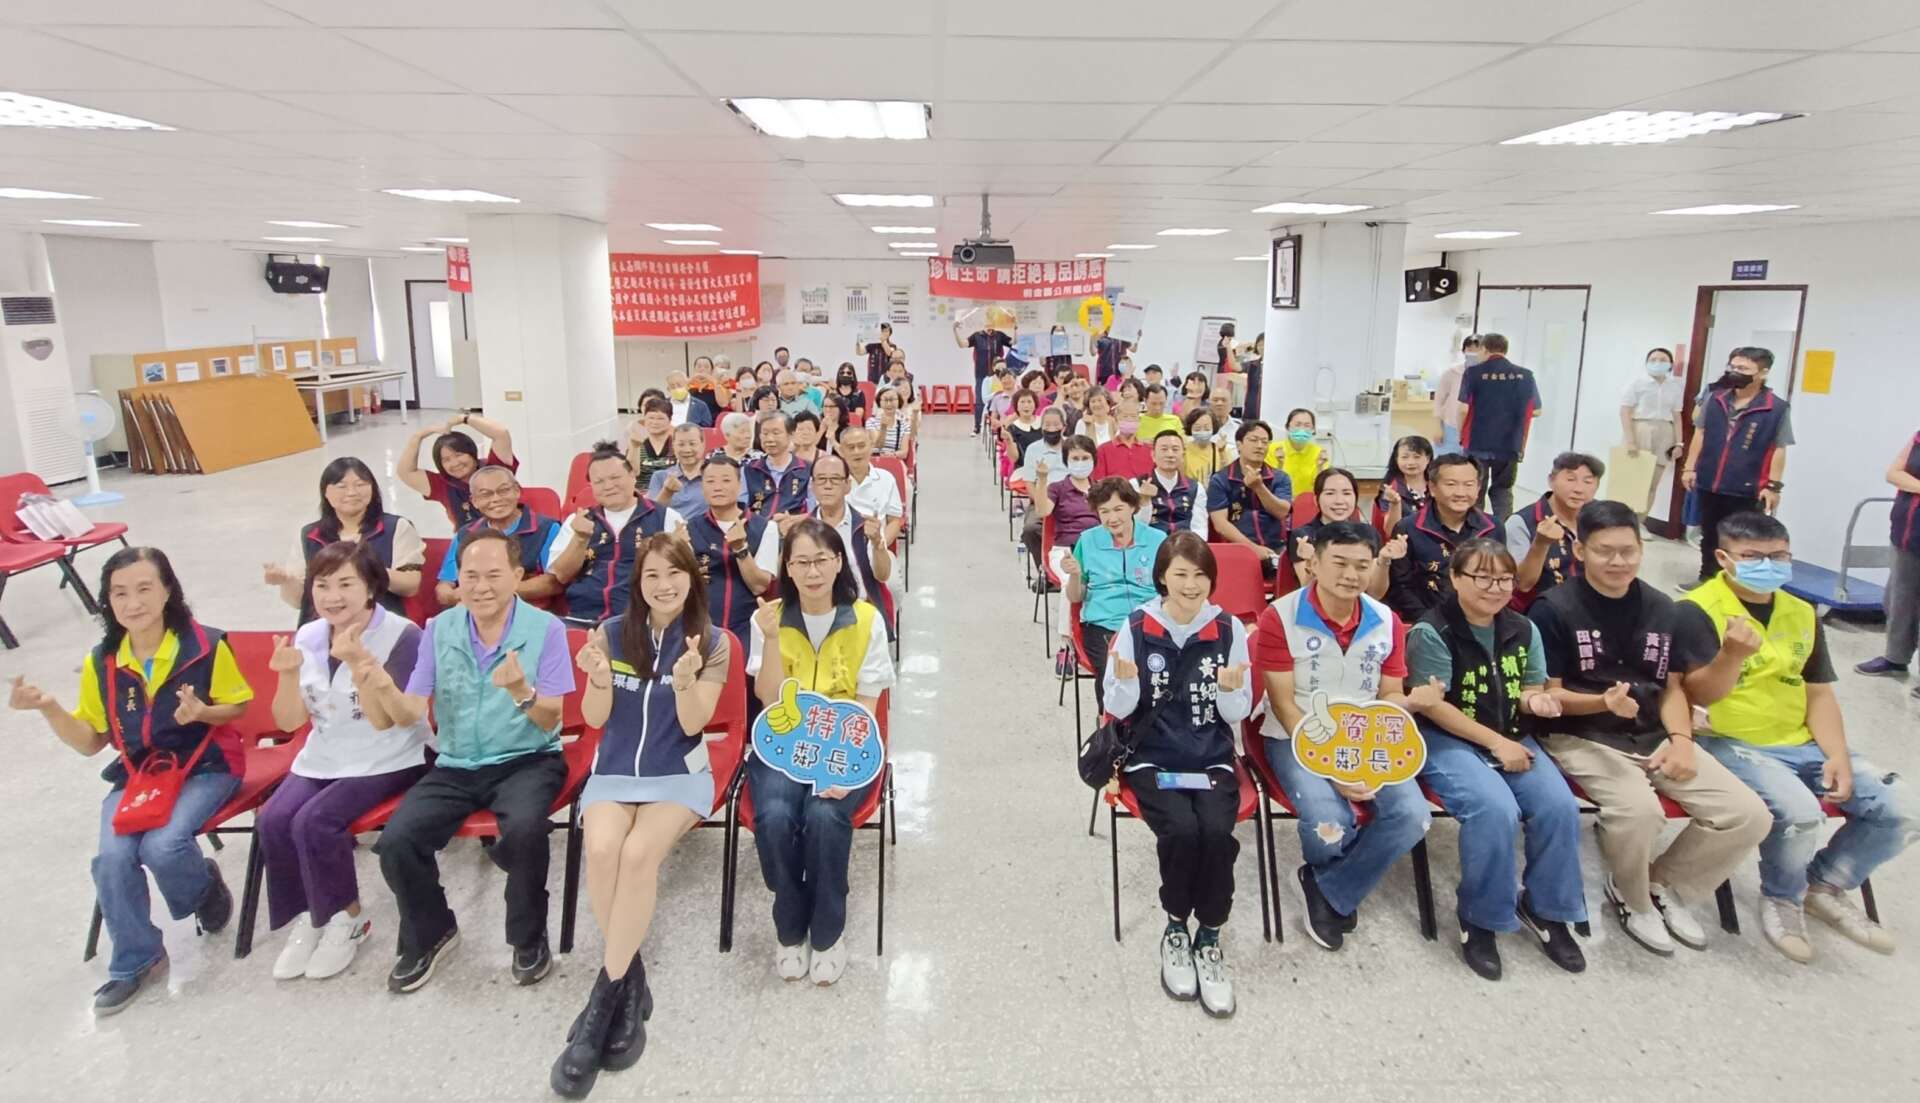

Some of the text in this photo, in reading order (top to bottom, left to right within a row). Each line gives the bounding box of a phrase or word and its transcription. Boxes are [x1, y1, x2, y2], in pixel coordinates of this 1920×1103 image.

[1198, 656, 1218, 726] 黃紹庭
[805, 705, 871, 748] 特優
[1341, 712, 1404, 744] 資深
[792, 740, 848, 776] 鄰長
[1335, 747, 1391, 773] 鄰長
